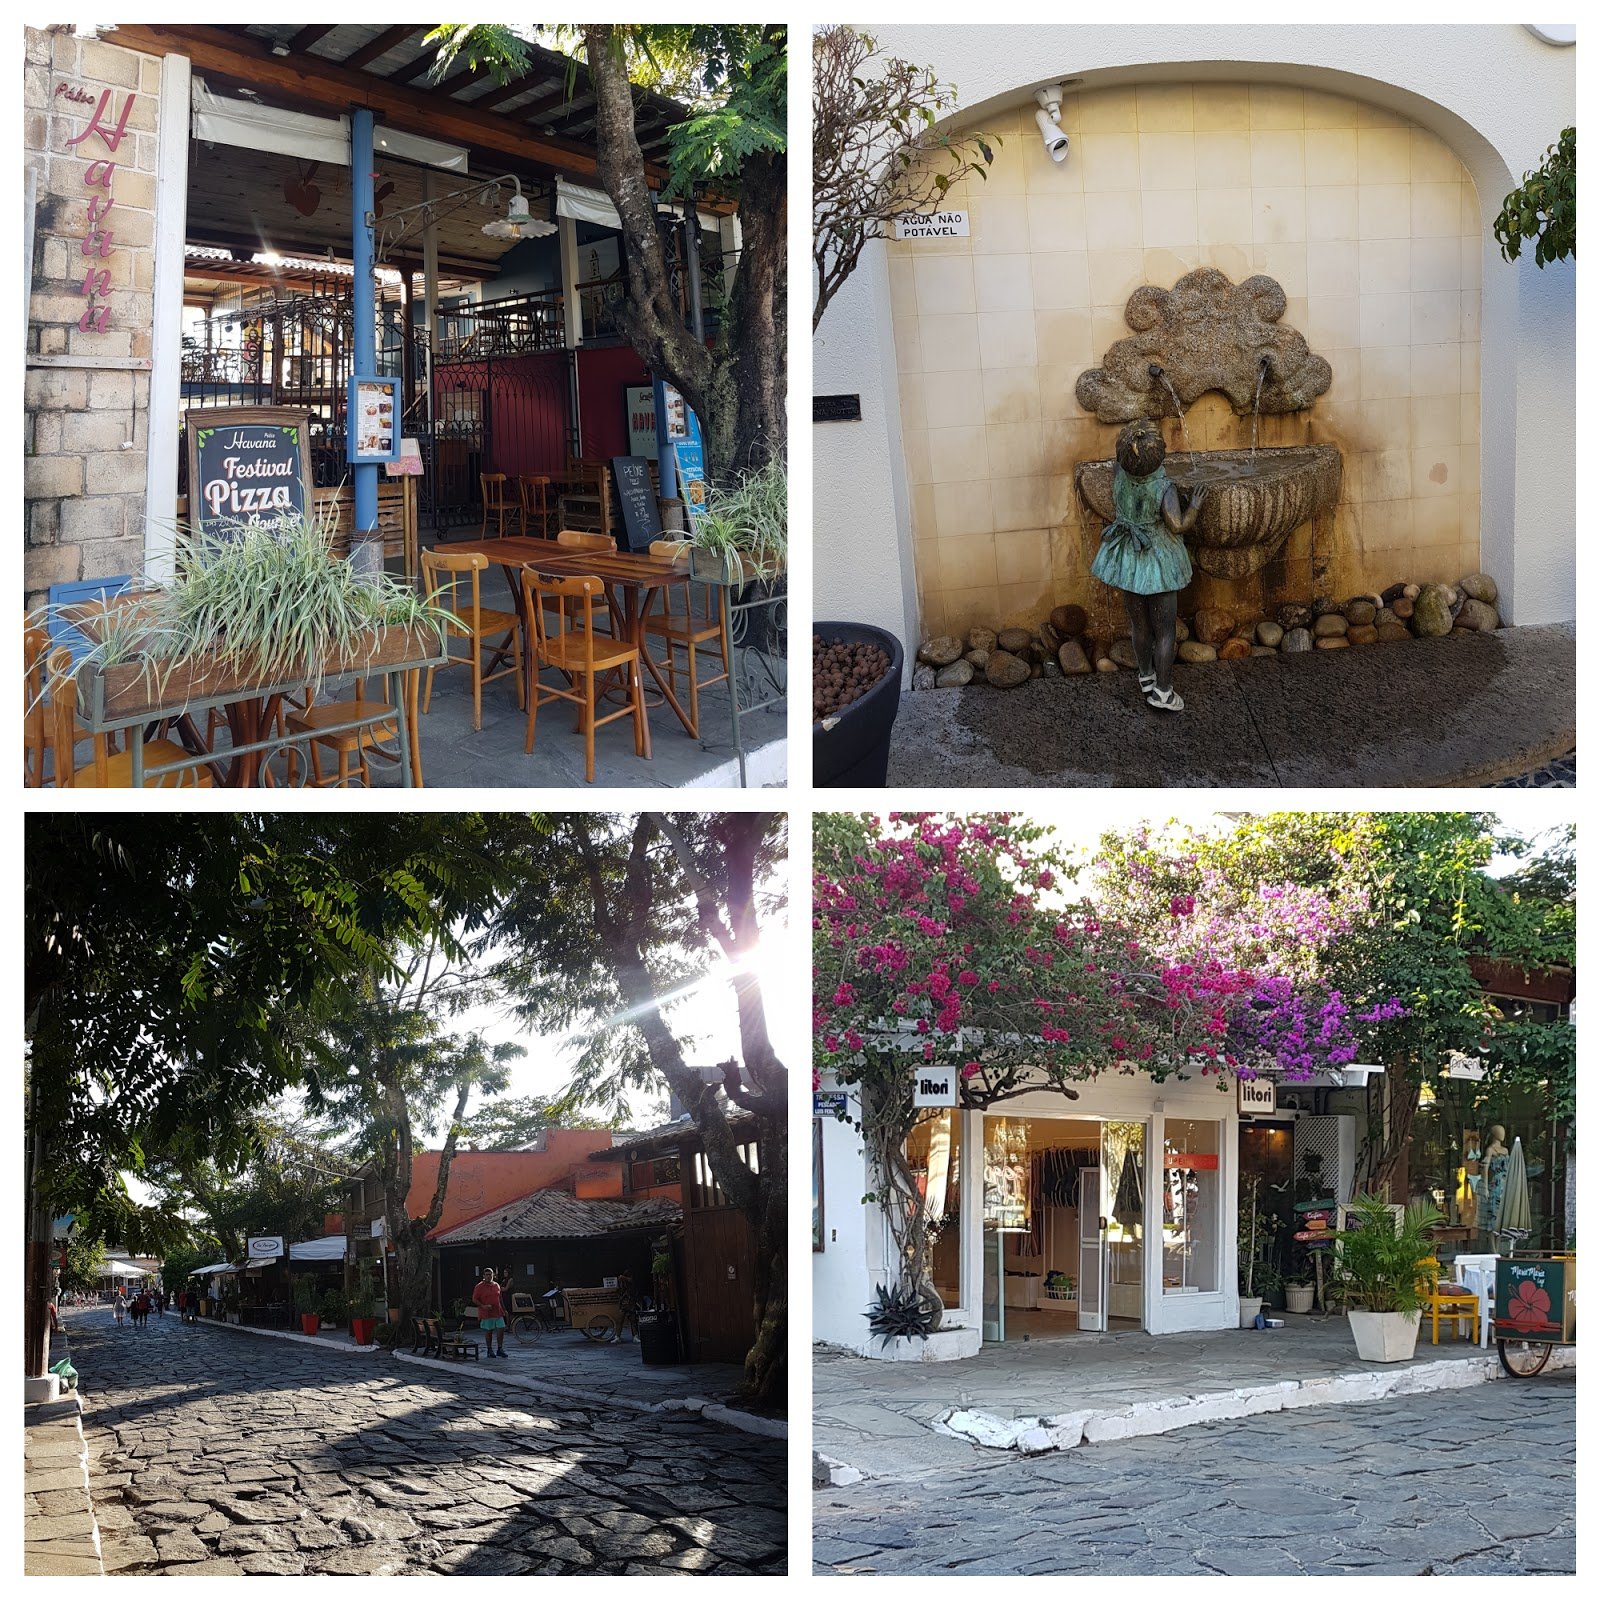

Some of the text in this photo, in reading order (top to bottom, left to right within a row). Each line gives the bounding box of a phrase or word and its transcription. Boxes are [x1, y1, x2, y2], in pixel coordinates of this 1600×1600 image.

[65, 88, 136, 334] Havana
[938, 212, 962, 224] NÃO
[904, 225, 958, 237] POTÁVEL
[223, 431, 277, 449] Havana
[223, 457, 293, 479] Festival
[204, 479, 293, 516] Pizza
[920, 1078, 948, 1095] litori
[1243, 1084, 1271, 1102] litori
